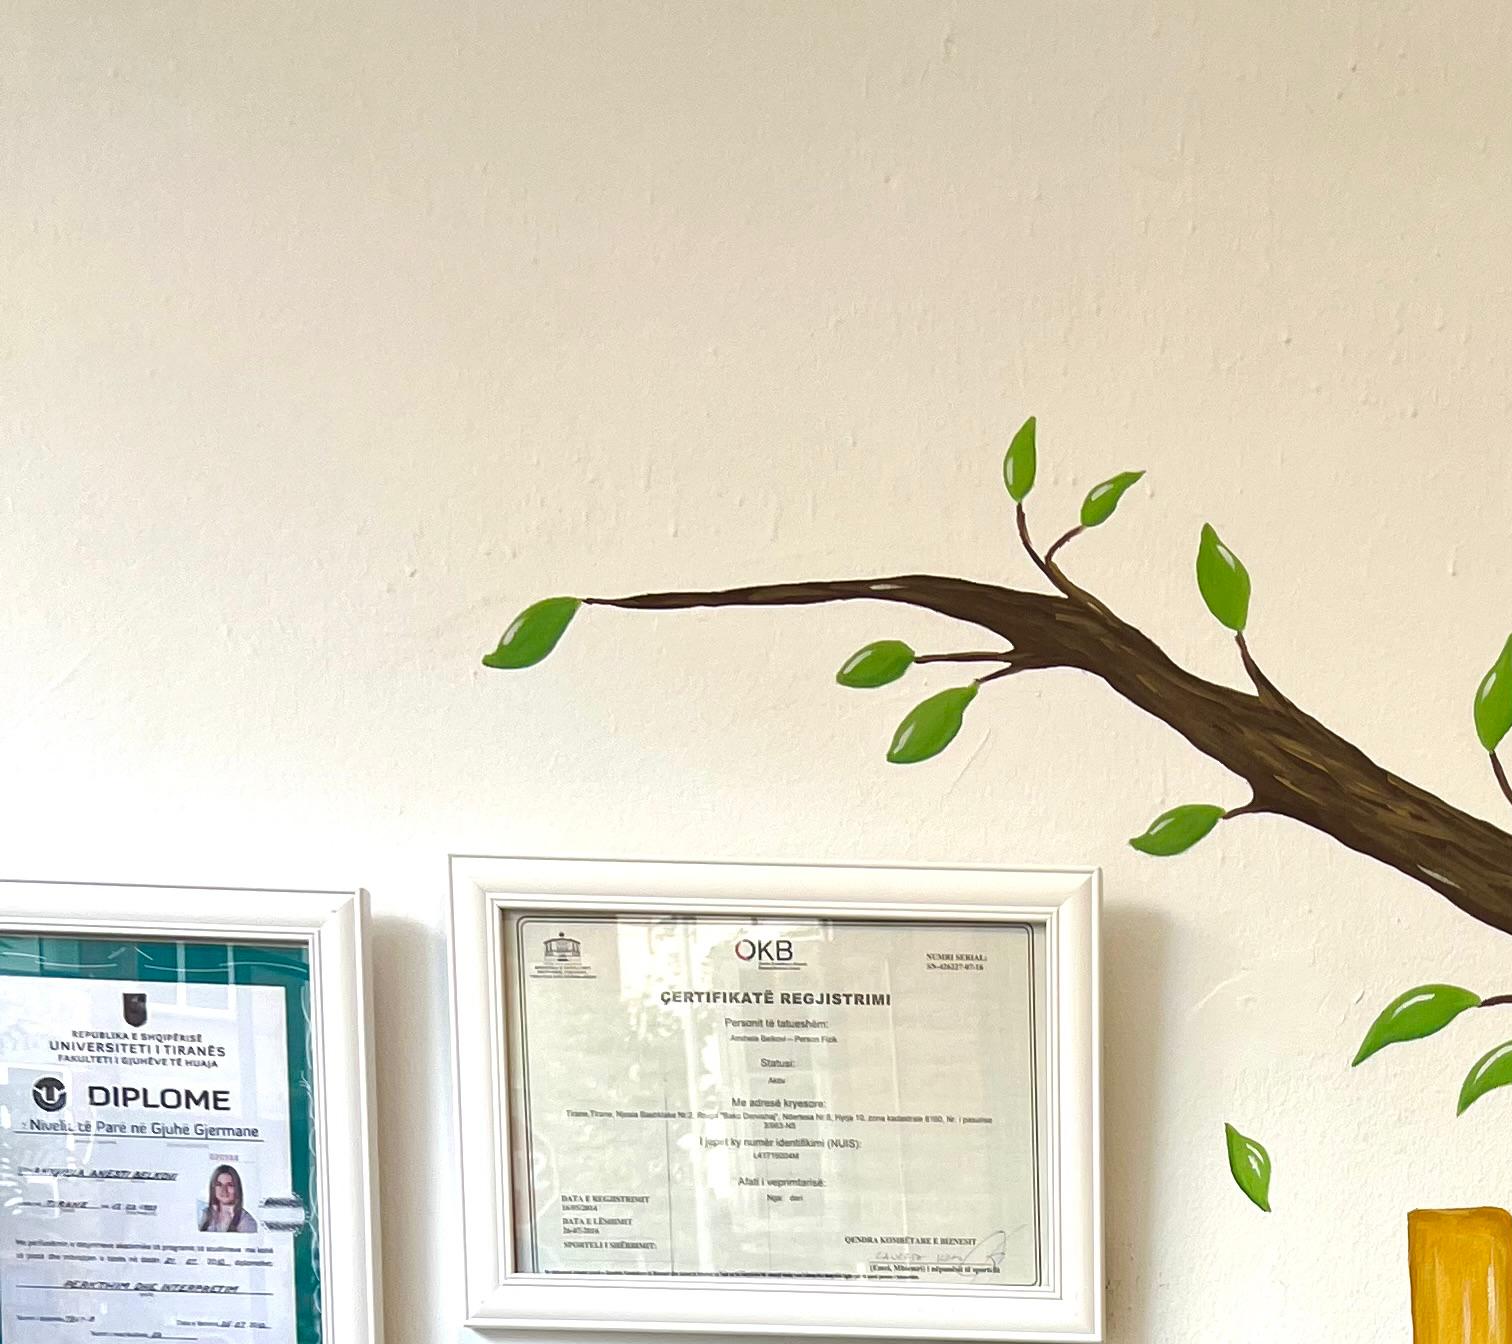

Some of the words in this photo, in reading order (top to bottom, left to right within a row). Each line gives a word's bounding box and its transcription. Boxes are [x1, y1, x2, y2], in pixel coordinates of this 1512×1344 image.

[735, 939, 793, 961] OKB
[660, 989, 774, 1005] ÇERTIFIKATË
[781, 992, 891, 1006] REGJISTRIMI
[724, 1018, 764, 1028] Personit
[765, 1019, 775, 1028] të
[71, 1030, 129, 1041] REPUBLIKA
[132, 1032, 138, 1041] E
[50, 1040, 151, 1055] UNIVERSITETI
[155, 1044, 160, 1055] I
[162, 1044, 226, 1058] TIRANËS
[88, 1085, 232, 1111] DIPLOME
[731, 1098, 747, 1107] Me
[194, 1123, 259, 1140] Gjermane
